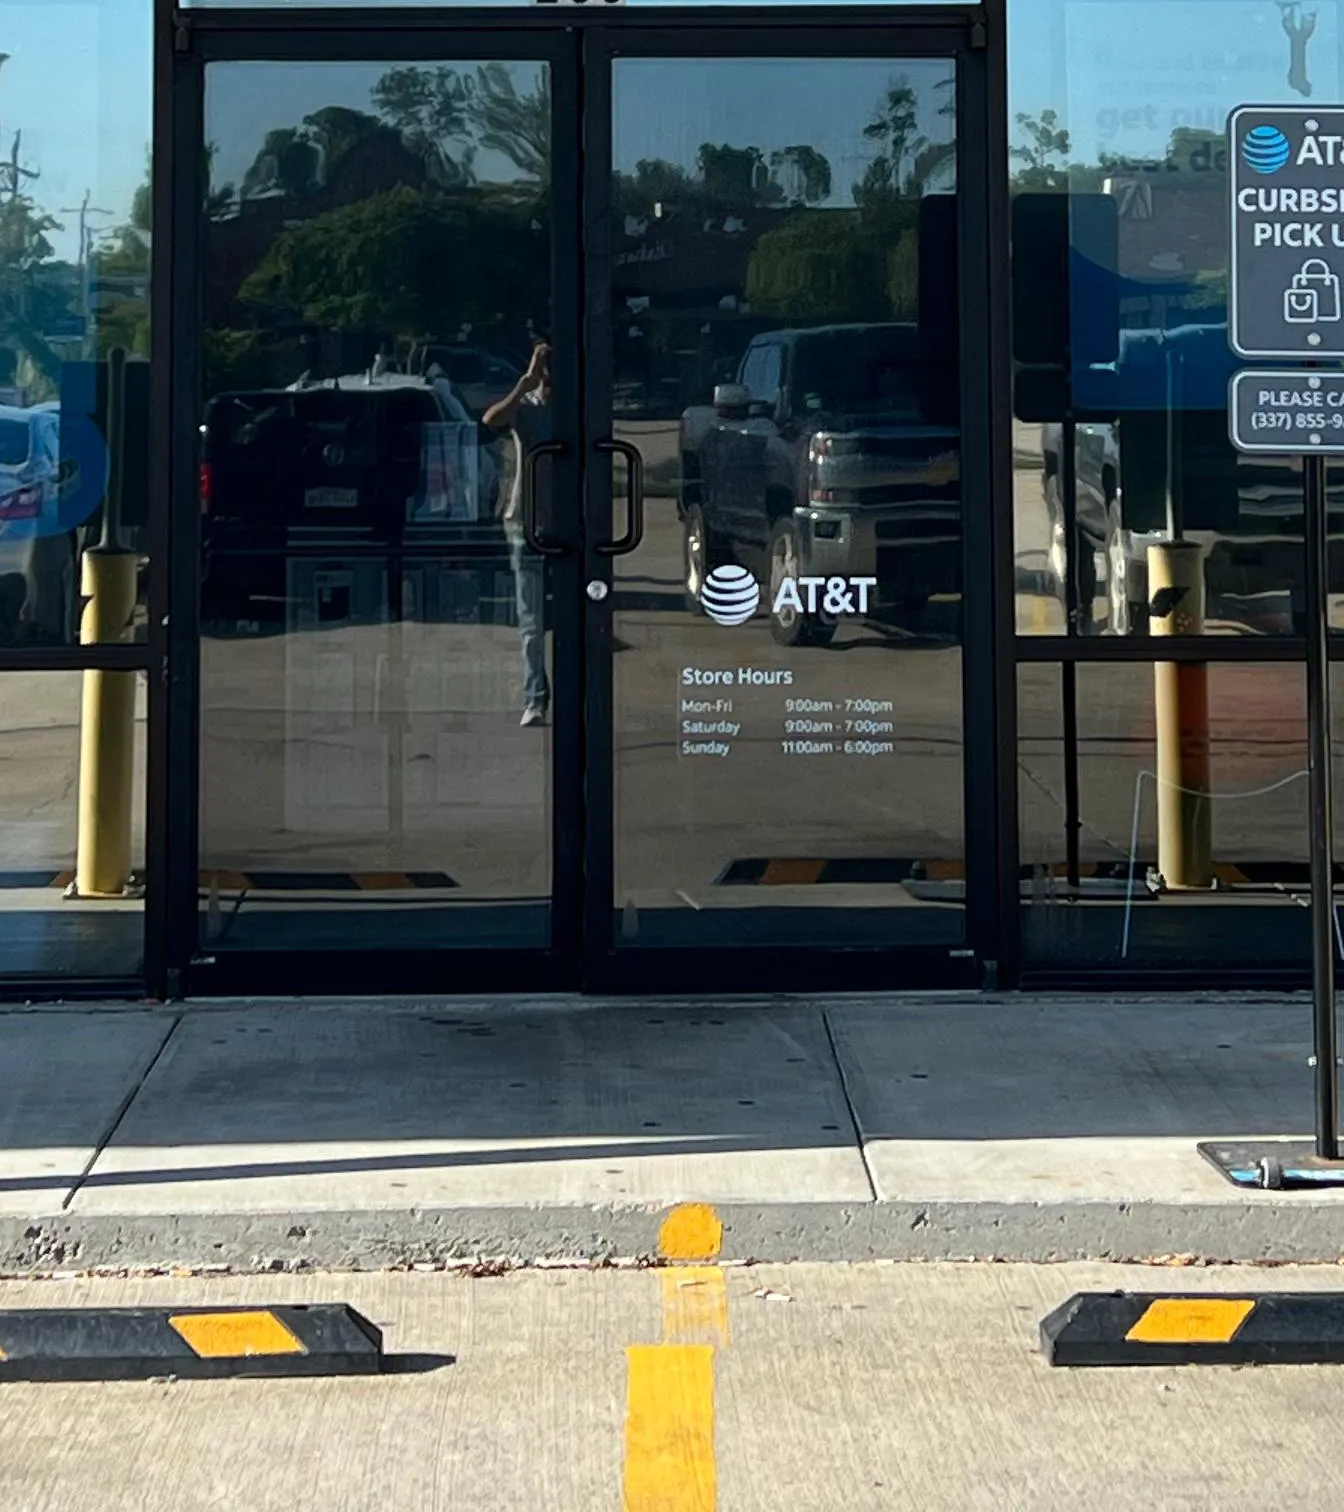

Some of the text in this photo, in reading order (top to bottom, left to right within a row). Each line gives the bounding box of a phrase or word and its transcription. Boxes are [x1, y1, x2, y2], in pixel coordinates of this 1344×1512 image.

[1254, 222, 1325, 248] PICK
[1259, 391, 1324, 407] PLEASE
[1251, 411, 1292, 430] (337)
[771, 576, 877, 614] AT&T
[682, 667, 793, 685] Store Hours
[681, 699, 733, 713] Mon-Fri
[682, 719, 740, 736] Saturday
[682, 740, 731, 756] Sunday
